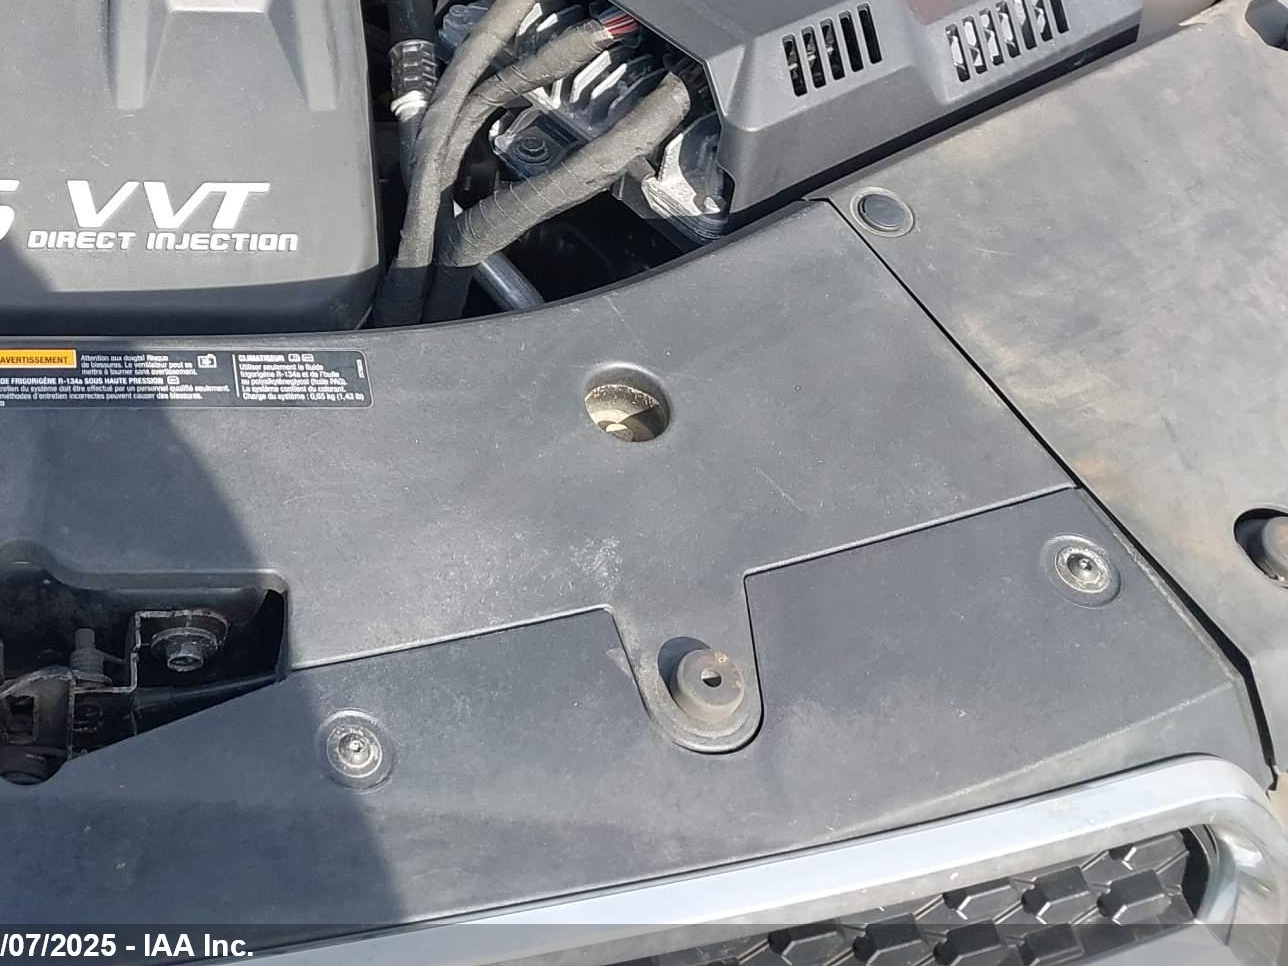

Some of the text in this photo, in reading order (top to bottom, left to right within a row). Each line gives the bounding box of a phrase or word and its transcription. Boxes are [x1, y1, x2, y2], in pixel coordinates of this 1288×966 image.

[67, 180, 271, 229] VVT
[28, 230, 298, 252] DIRECT INJECTION
[0, 356, 68, 364] AVERTISSEMENT
[11, 376, 57, 385] FRIGORIGÈNE
[58, 377, 82, 385] R-134a
[84, 377, 104, 385] SOUS
[105, 377, 128, 385] HAUTE
[129, 377, 164, 385] PRESSION
